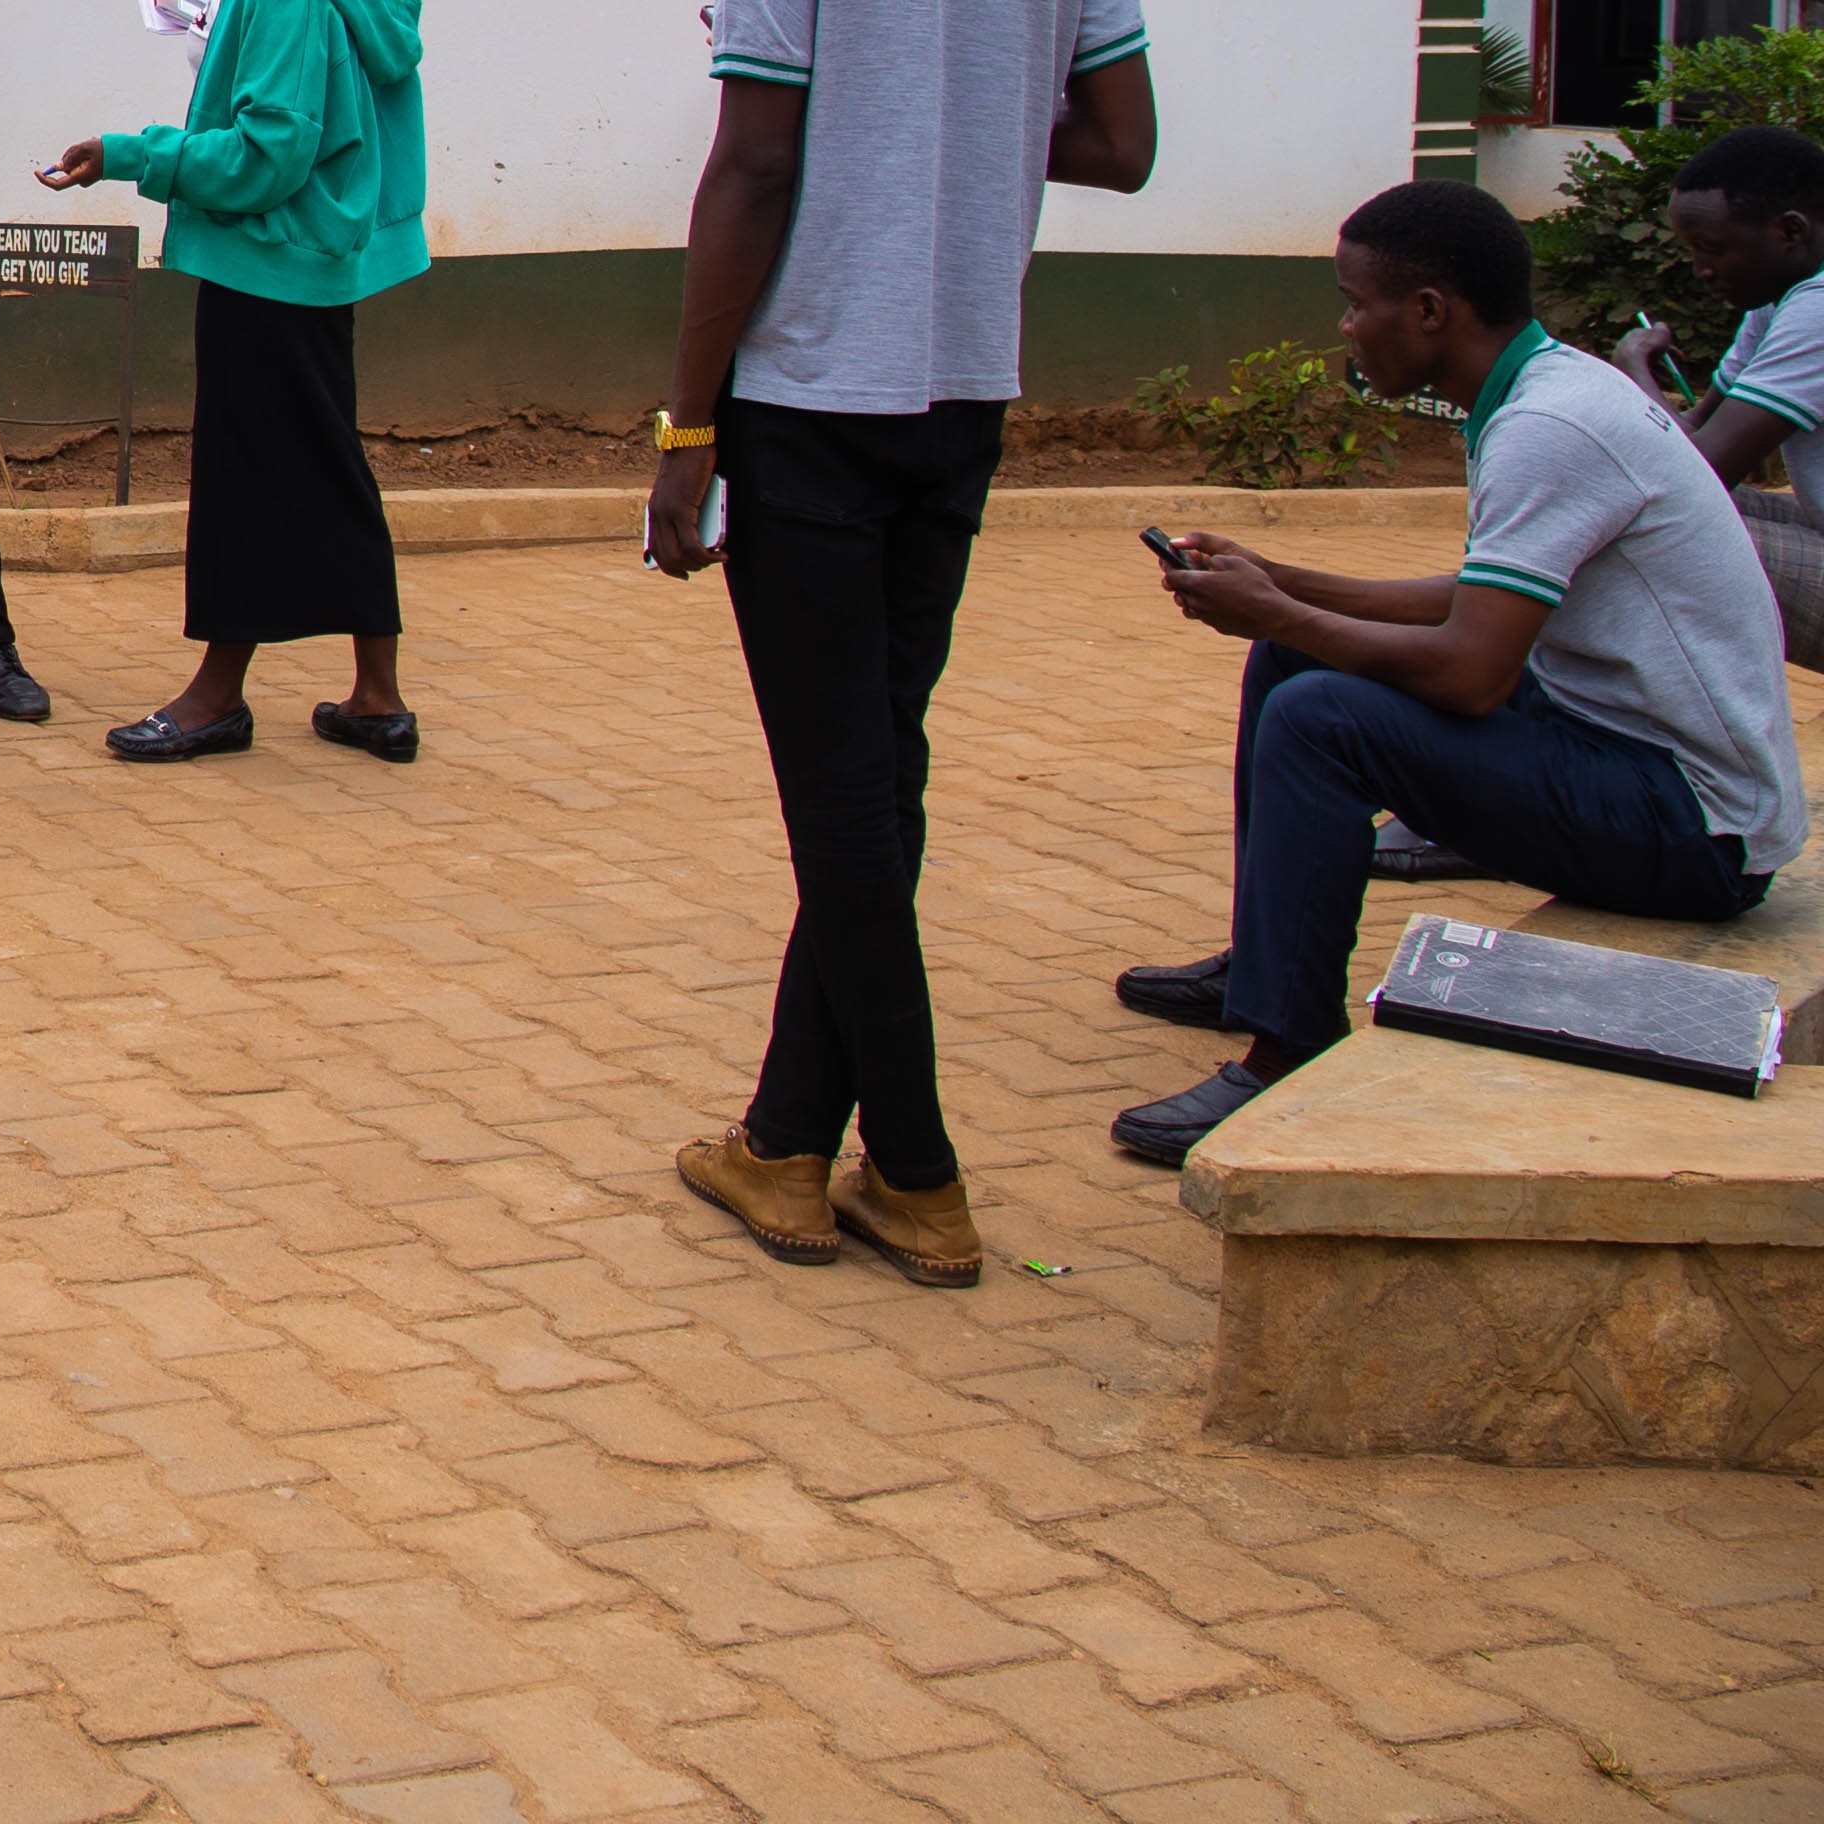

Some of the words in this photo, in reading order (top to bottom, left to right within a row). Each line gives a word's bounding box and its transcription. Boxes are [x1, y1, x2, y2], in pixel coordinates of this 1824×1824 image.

[34, 229, 61, 254] YOU
[64, 230, 107, 256] TEACH
[1, 258, 27, 283] GET
[29, 260, 55, 285] YOU
[58, 261, 90, 286] GIVE
